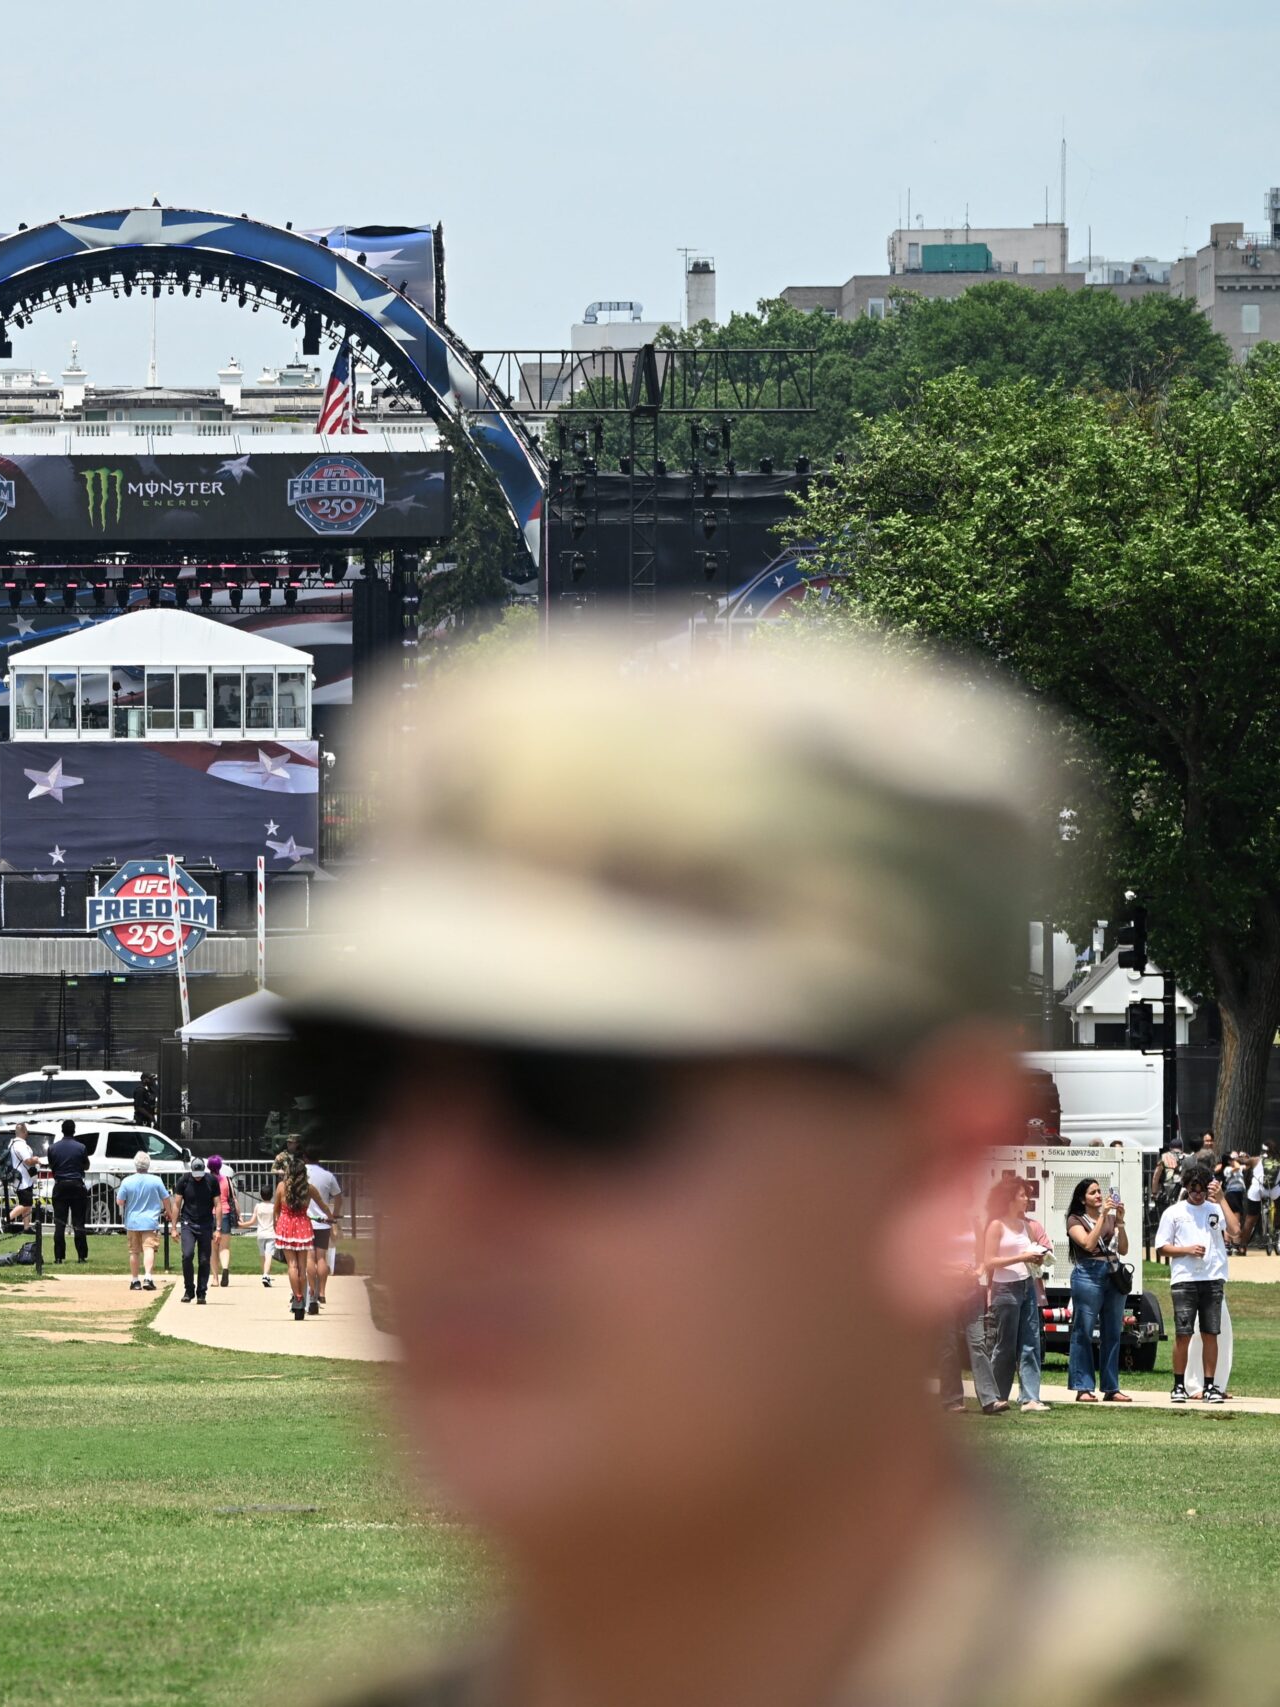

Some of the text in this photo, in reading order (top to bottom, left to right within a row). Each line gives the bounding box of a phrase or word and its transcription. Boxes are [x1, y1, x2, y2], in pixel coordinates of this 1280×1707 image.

[324, 468, 349, 478] UFC
[128, 479, 226, 497] MONSTER
[289, 480, 382, 501] FREEDOM
[318, 498, 357, 519] 250
[134, 880, 169, 894] UFC
[88, 898, 215, 930] FREEDOM
[127, 925, 179, 953] 250
